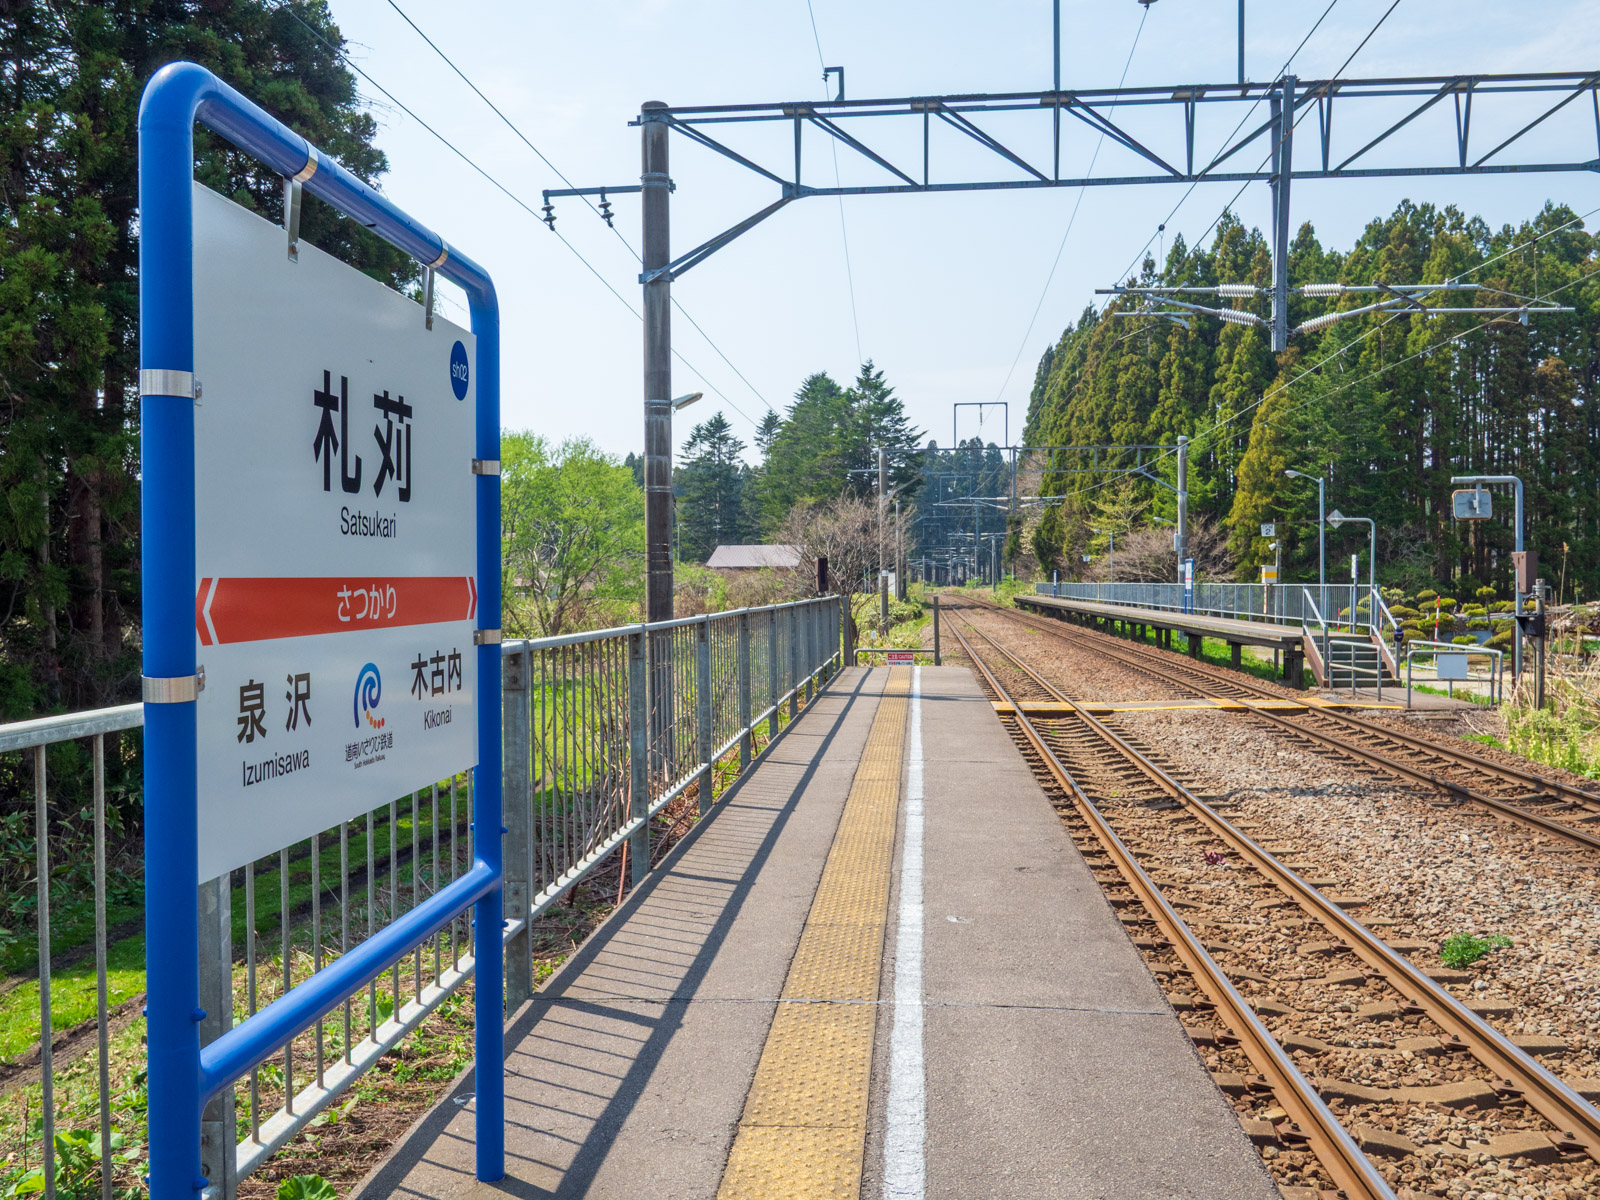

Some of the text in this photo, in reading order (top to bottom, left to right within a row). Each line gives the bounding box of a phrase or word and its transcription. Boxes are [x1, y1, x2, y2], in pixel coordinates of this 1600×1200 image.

[453, 361, 468, 382] sh02
[313, 369, 413, 503] 札苅
[340, 505, 397, 539] Satsukari
[337, 584, 397, 622] さつかり
[410, 647, 462, 701] 木古内
[237, 672, 312, 744] 泉沢
[424, 704, 452, 731] Kikonai
[345, 731, 393, 761] 道南いさりび鉄道
[242, 749, 310, 788] Izumisawa
